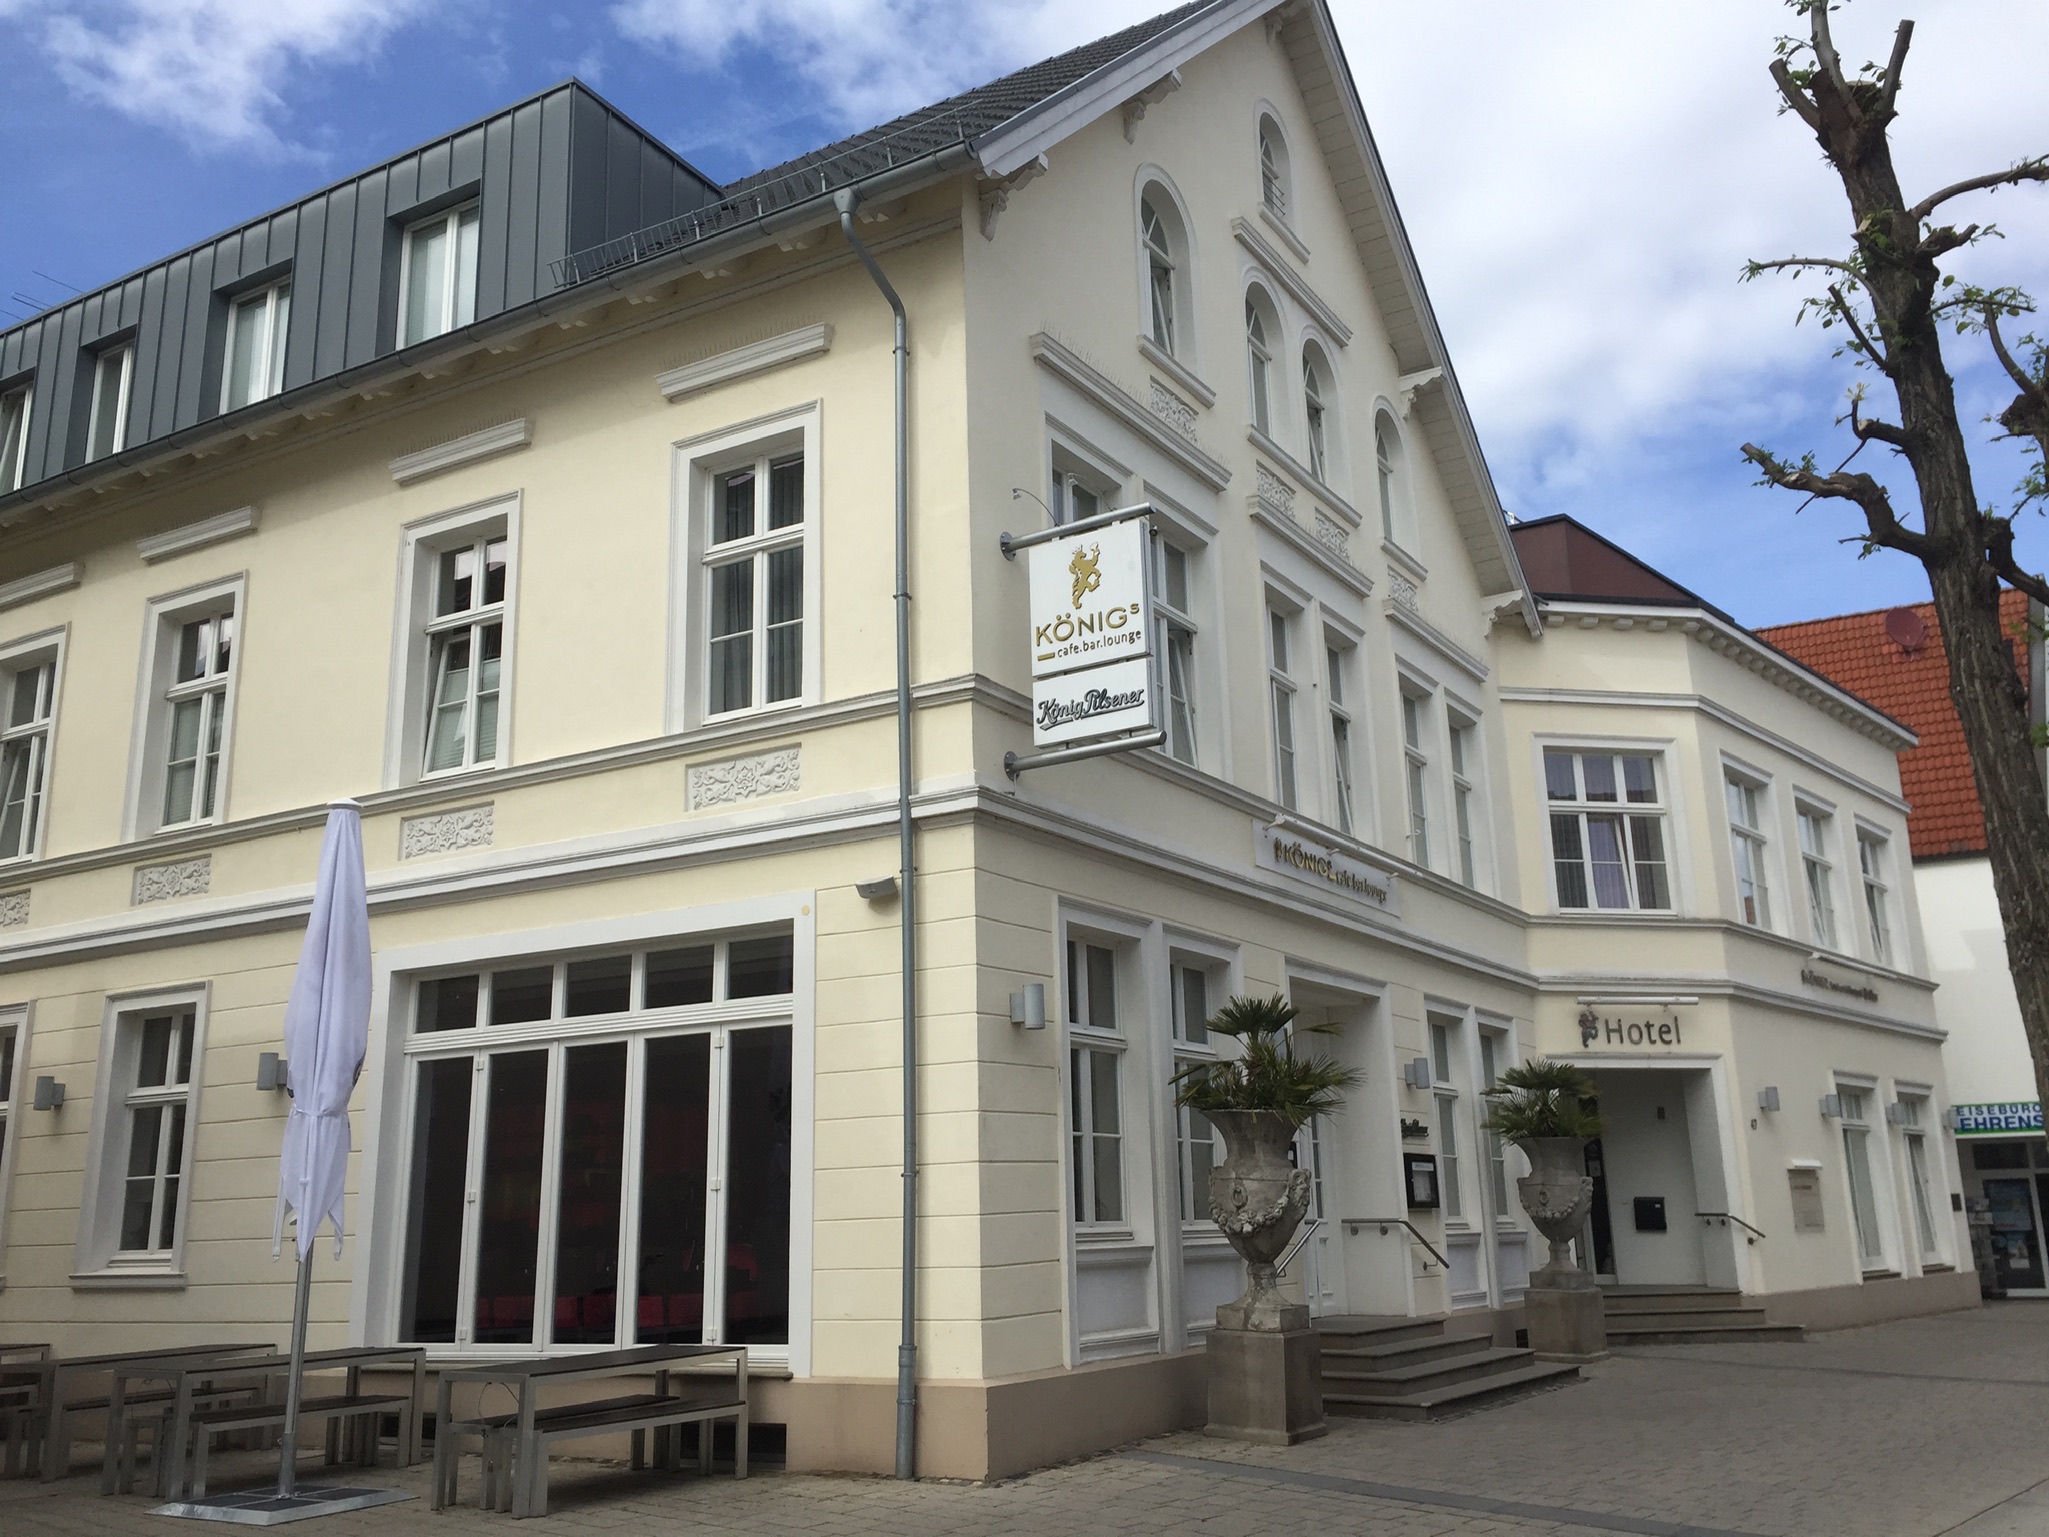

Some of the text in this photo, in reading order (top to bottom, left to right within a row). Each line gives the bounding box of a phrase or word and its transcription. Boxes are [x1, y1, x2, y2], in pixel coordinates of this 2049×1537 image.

[1057, 630, 1142, 658] cafe.bar.lounge
[1036, 688, 1145, 725] König Pilsener
[1604, 1015, 1683, 1045] Hotel
[1956, 1102, 2042, 1117] EISEBÜRO
[1958, 1114, 2045, 1132] EHRENS
